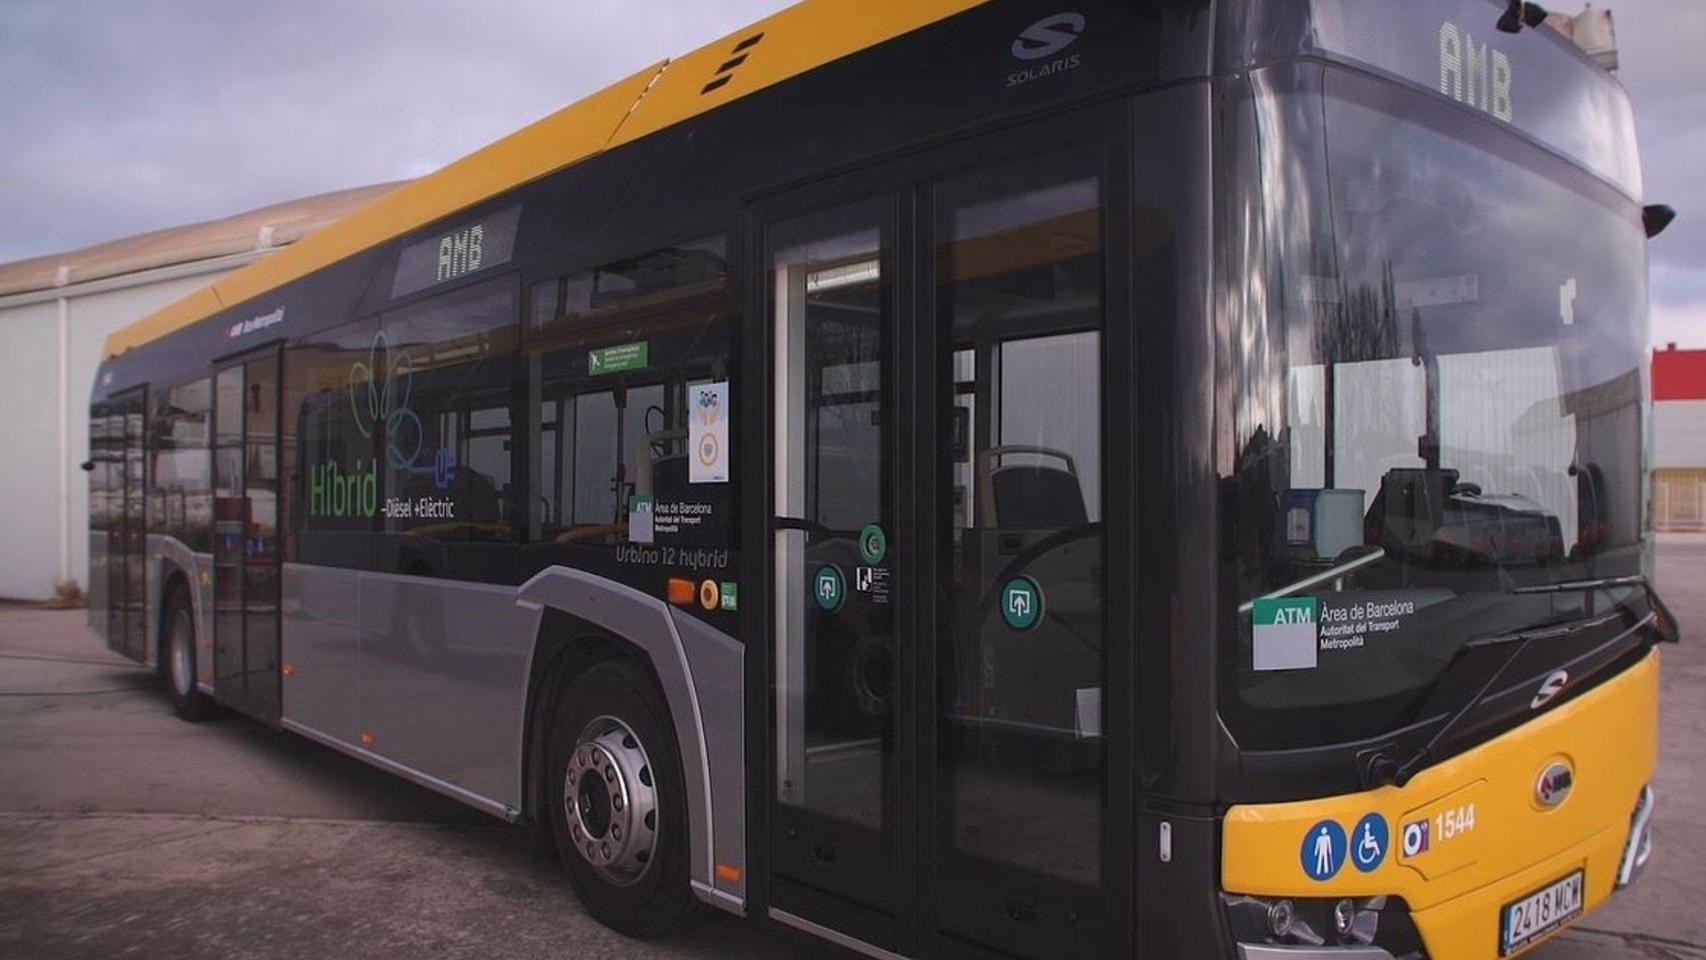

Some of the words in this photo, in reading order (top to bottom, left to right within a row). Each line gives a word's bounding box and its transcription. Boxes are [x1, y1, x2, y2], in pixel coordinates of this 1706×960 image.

[1006, 54, 1080, 87] SOLARIS
[1439, 21, 1513, 123] AMB
[437, 223, 483, 281] AMB
[311, 457, 377, 518] Híbrid
[636, 502, 652, 513] ATM
[670, 502, 679, 514] de
[680, 502, 712, 514] Barcelona
[616, 545, 658, 565] Urbino
[662, 546, 675, 566] 12
[680, 547, 728, 571] hybrid
[1273, 607, 1311, 625] ATM
[1320, 601, 1347, 623] Àrea
[1350, 603, 1364, 621] de
[1366, 600, 1414, 619] Barcelona
[1320, 623, 1355, 637] Autoritat
[1355, 622, 1367, 634] del
[1368, 619, 1400, 634] Transport
[1320, 635, 1364, 651] Metropolità
[1435, 803, 1476, 841] 1544
[1513, 893, 1551, 938] 2418
